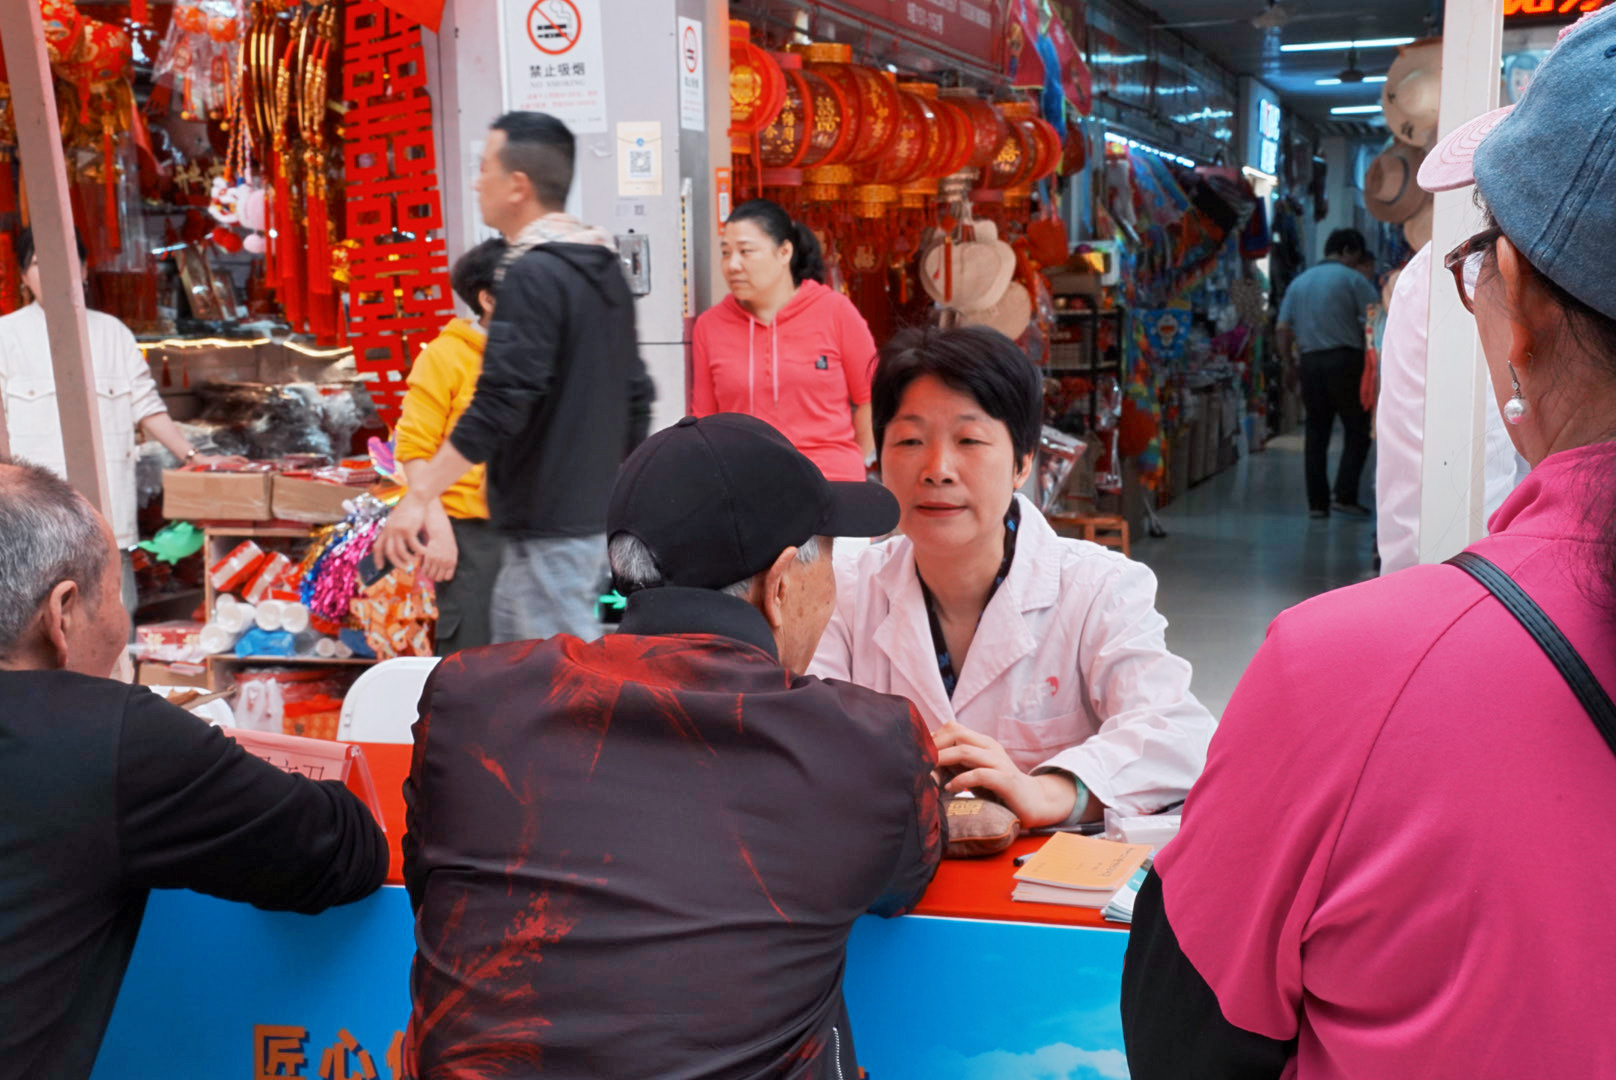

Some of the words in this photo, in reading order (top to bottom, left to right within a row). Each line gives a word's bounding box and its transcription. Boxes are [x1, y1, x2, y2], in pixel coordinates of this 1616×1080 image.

[529, 62, 586, 78] 禁止吸烟
[253, 1024, 406, 1080] 匠心
